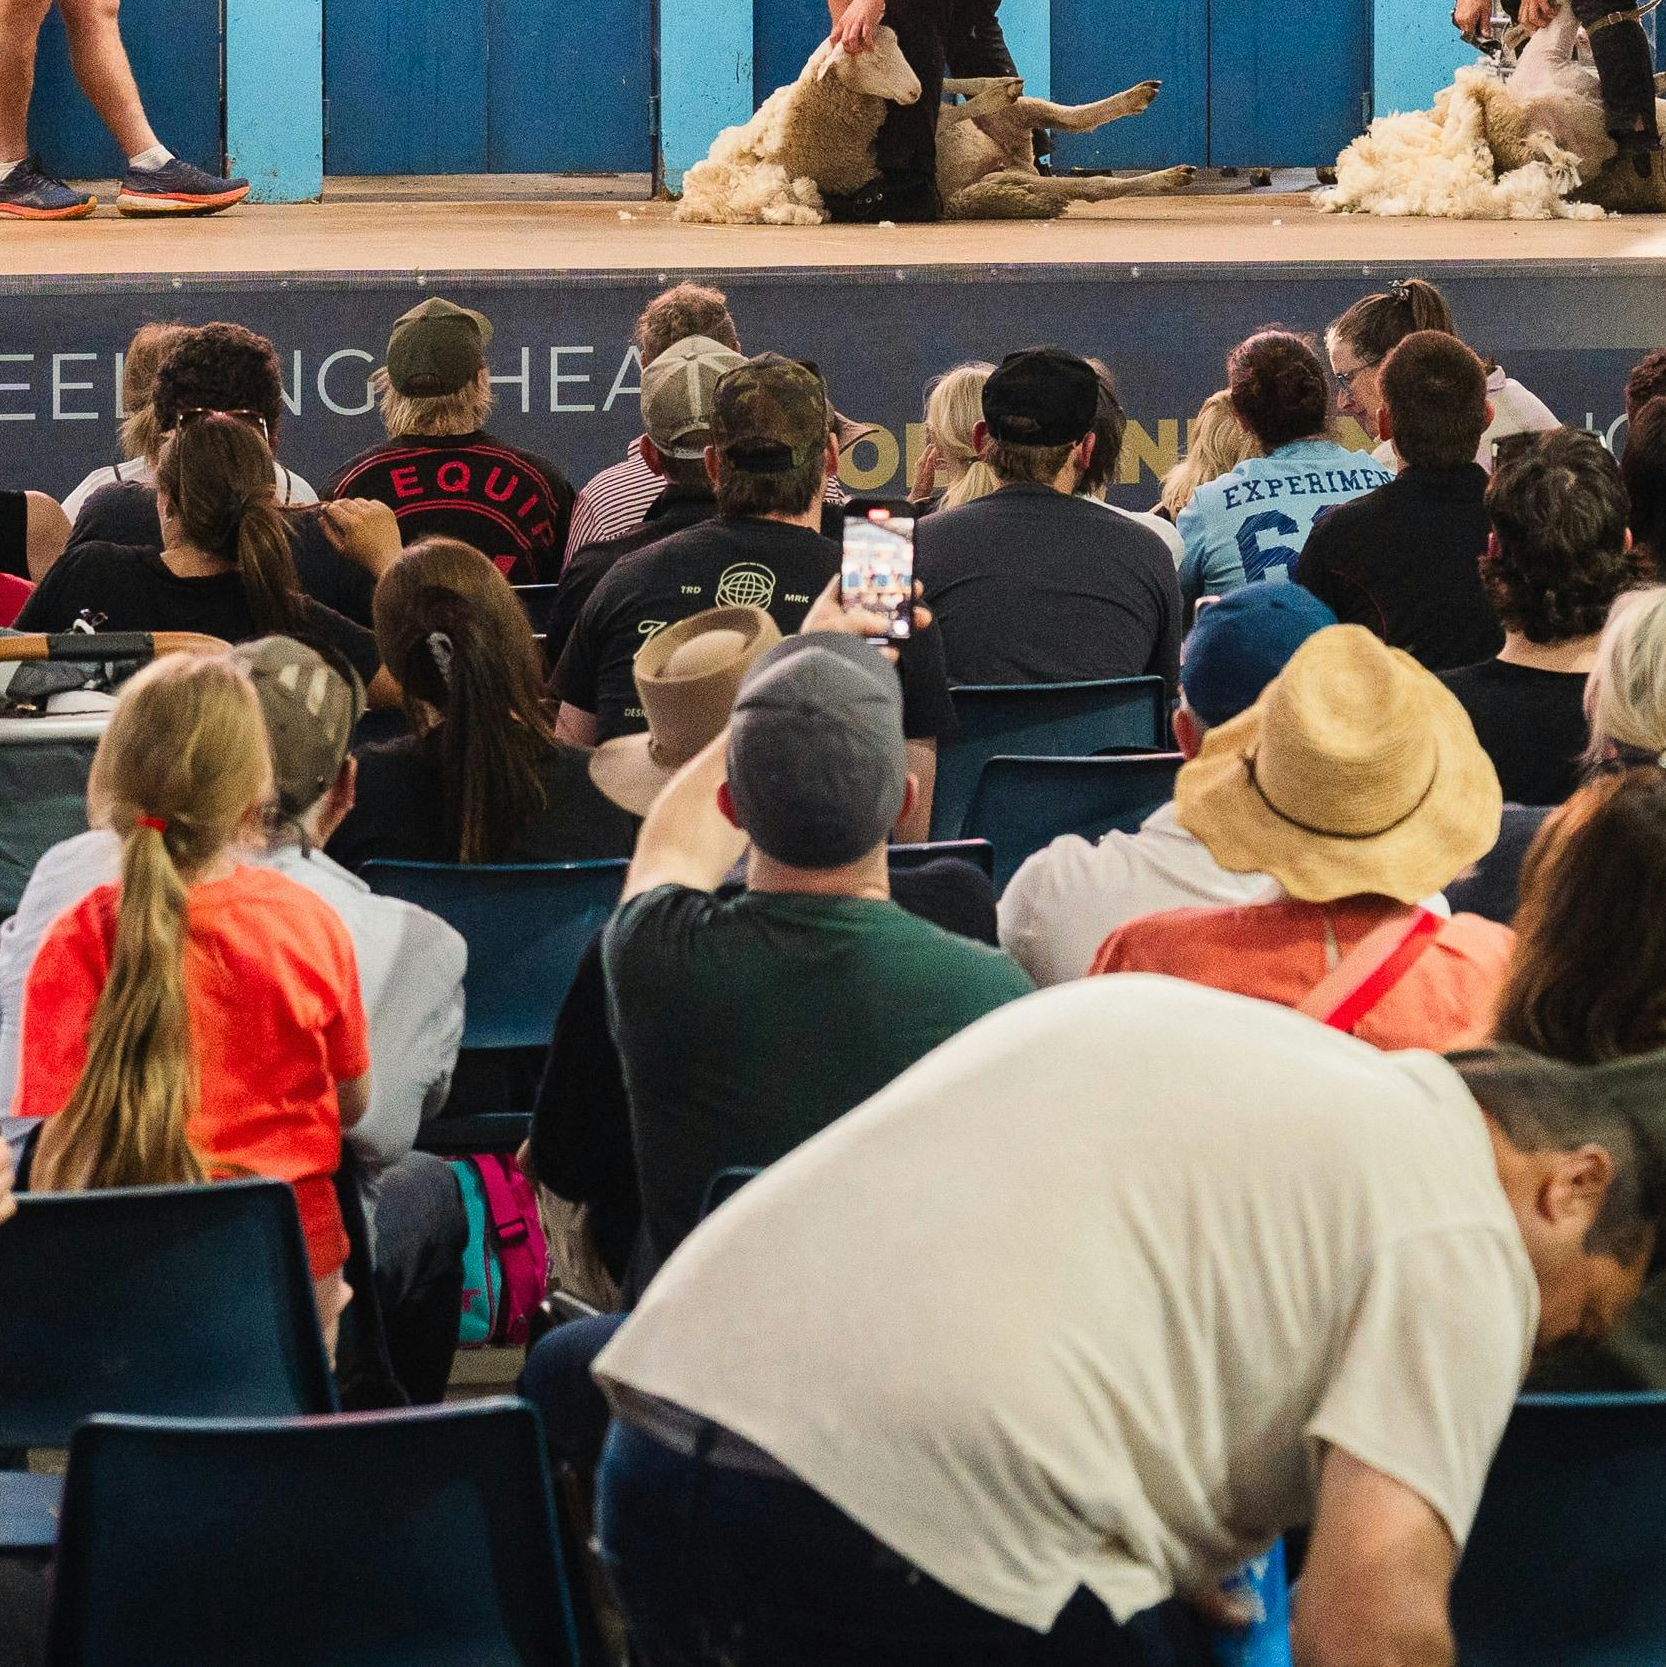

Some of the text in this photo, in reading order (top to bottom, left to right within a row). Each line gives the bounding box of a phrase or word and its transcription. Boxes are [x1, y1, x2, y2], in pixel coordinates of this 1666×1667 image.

[1222, 470, 1398, 511] EXPERIMEN
[680, 585, 702, 595] TRD
[783, 593, 810, 604] MRK
